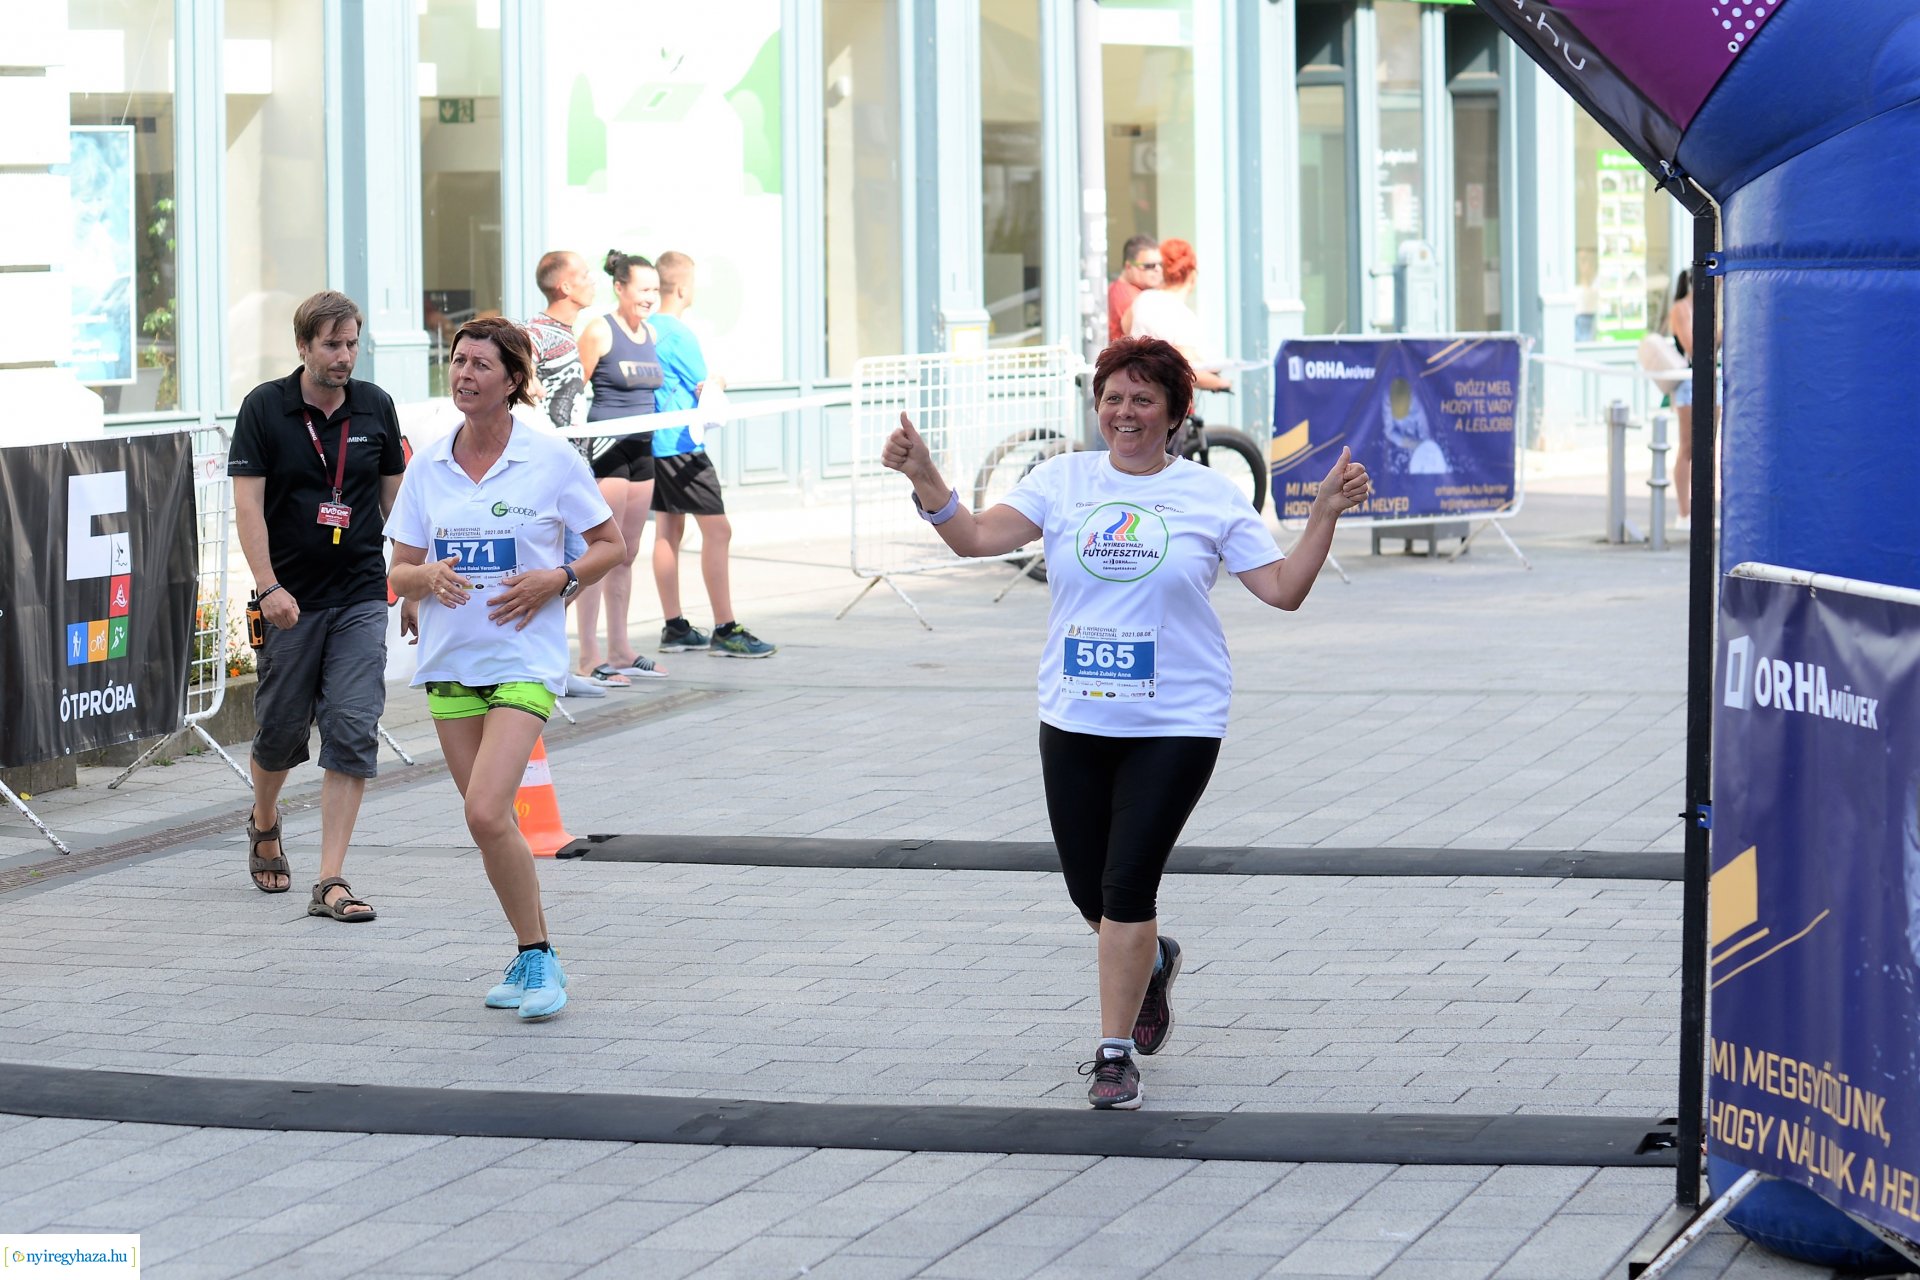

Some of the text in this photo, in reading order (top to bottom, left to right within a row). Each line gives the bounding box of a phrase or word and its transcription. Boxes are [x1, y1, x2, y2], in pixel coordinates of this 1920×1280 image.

[1512, 0, 1586, 71] .hu
[1441, 398, 1513, 415] HOGY TE VAGY
[1455, 418, 1463, 432] A
[1285, 482, 1299, 496] MI
[1371, 496, 1410, 512] HELYED
[446, 540, 495, 564] 571
[1082, 548, 1160, 559] FUTÓFESZTIVÁL
[1076, 641, 1136, 670] 565
[59, 679, 137, 723] ÖTPRÓBA
[1710, 1036, 1737, 1083] MI
[1709, 1097, 1775, 1155] HOGY
[1859, 1157, 1876, 1202] A
